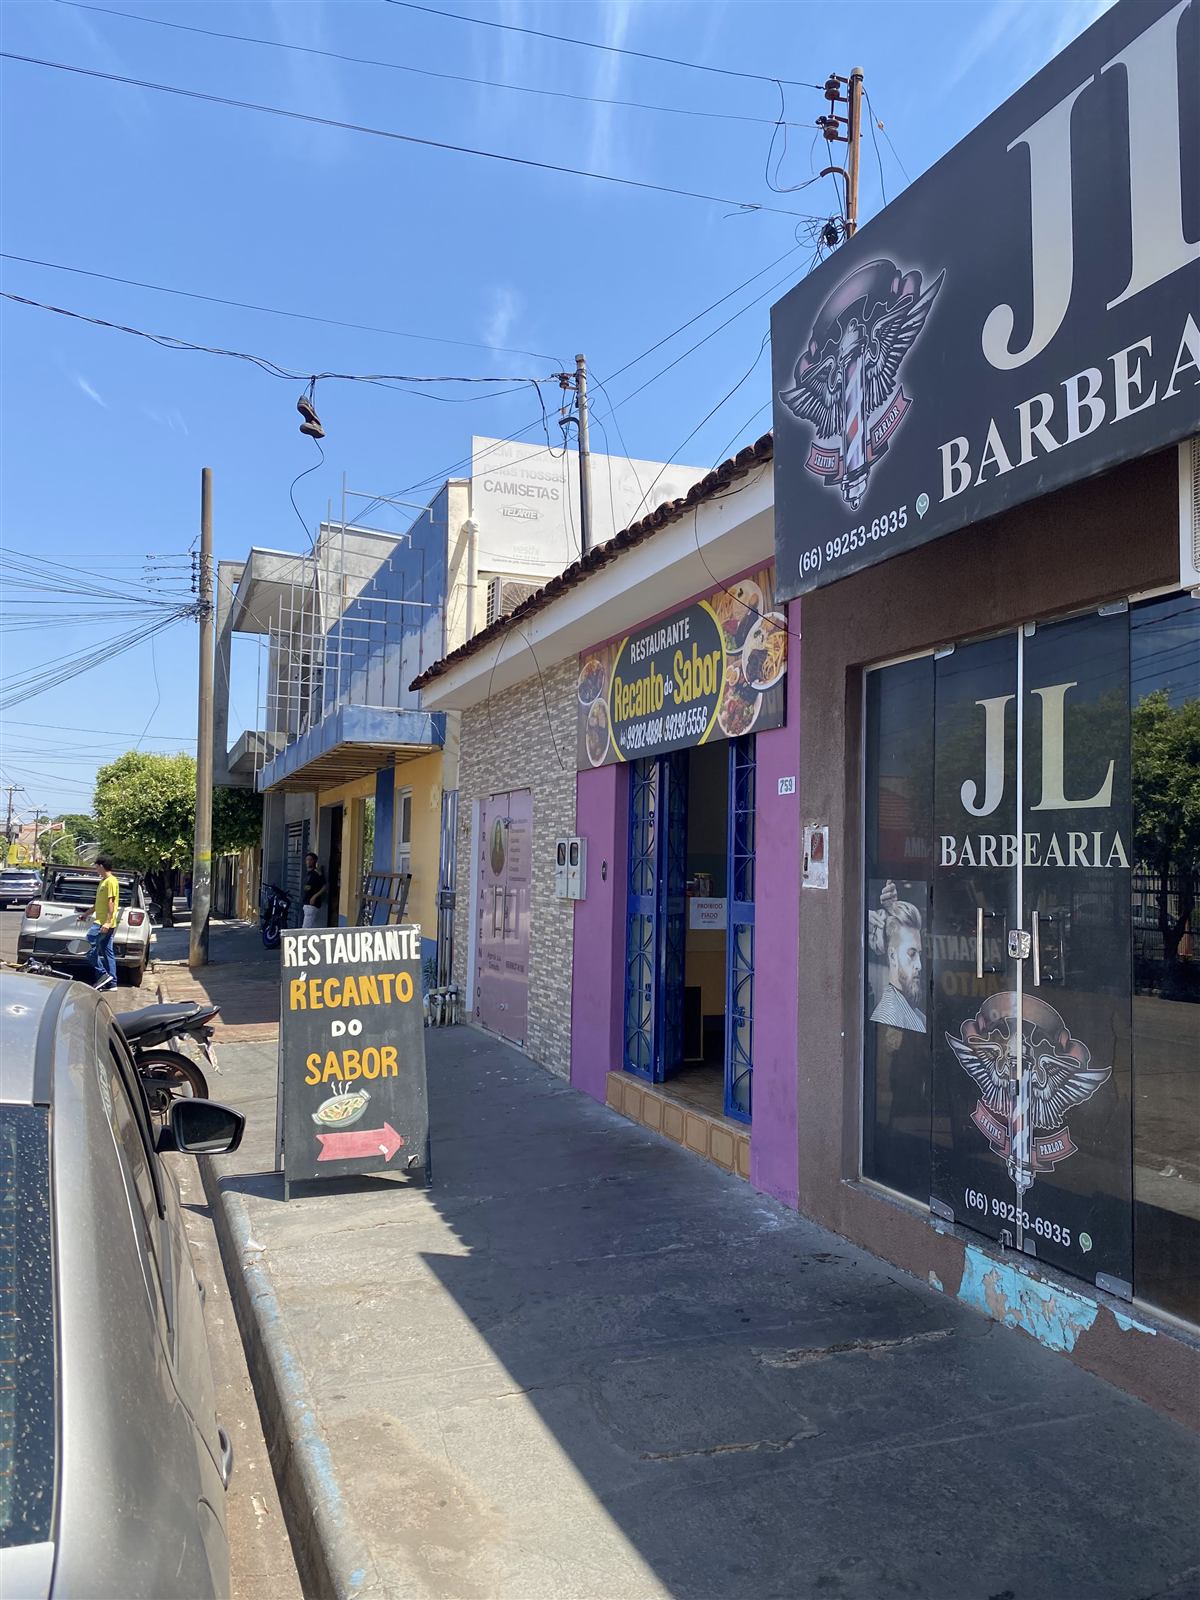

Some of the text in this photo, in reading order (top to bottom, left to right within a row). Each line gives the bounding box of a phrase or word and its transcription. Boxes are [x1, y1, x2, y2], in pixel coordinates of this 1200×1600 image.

[874, 405, 900, 443] PARLOR
[483, 480, 560, 501] CAMISETAS
[799, 505, 908, 578] (66) 99253-6935
[630, 617, 690, 665] RESTAURANTE
[614, 642, 721, 723] Recanto do Sabor
[960, 682, 1115, 817] JL
[780, 778, 793, 793] 759
[939, 831, 1131, 868] BARBEARIA
[283, 930, 421, 967] RESTAURANTE
[290, 971, 414, 1011] RECANTO
[331, 1018, 363, 1038] DO
[305, 1046, 399, 1086] SABOR
[1039, 1140, 1065, 1156] PARLOR
[964, 1188, 1071, 1247] (66) 99253-6935
